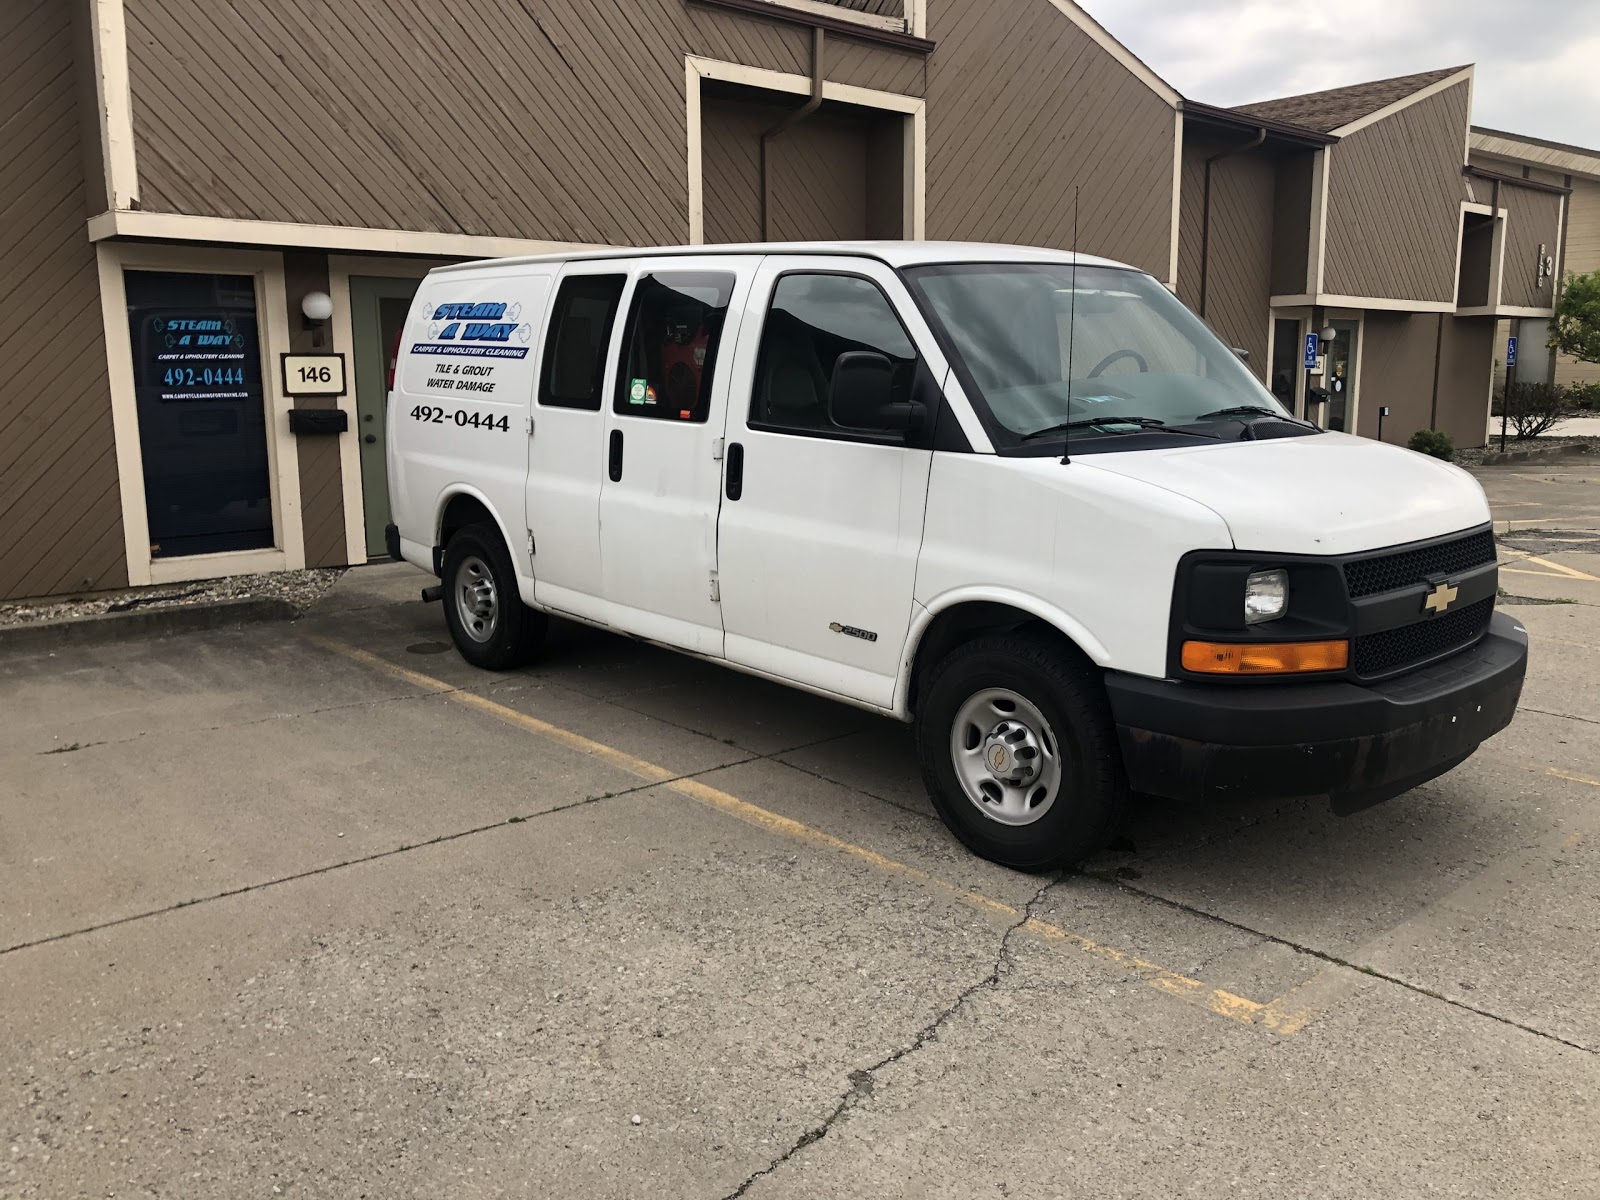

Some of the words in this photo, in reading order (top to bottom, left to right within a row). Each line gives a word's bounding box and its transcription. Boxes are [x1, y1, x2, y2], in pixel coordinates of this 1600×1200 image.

[1546, 256, 1552, 275] 3
[432, 303, 507, 320] STEAM
[167, 320, 221, 330] STEAM
[438, 323, 461, 340] A
[460, 323, 519, 342] WAY
[179, 335, 190, 345] A
[198, 335, 233, 345] WAY
[413, 345, 437, 353] CARPET
[443, 346, 486, 355] UPHOLSTERY
[485, 348, 525, 357] CLEANING
[164, 367, 244, 386] 492-0444
[298, 366, 331, 383] 146
[435, 363, 452, 374] TILE
[453, 364, 461, 374] &
[461, 365, 494, 377] GROUT
[426, 378, 455, 390] WATER
[455, 380, 496, 393] DAMAGE
[410, 405, 510, 432] 492-0444
[844, 625, 877, 642] 2500
